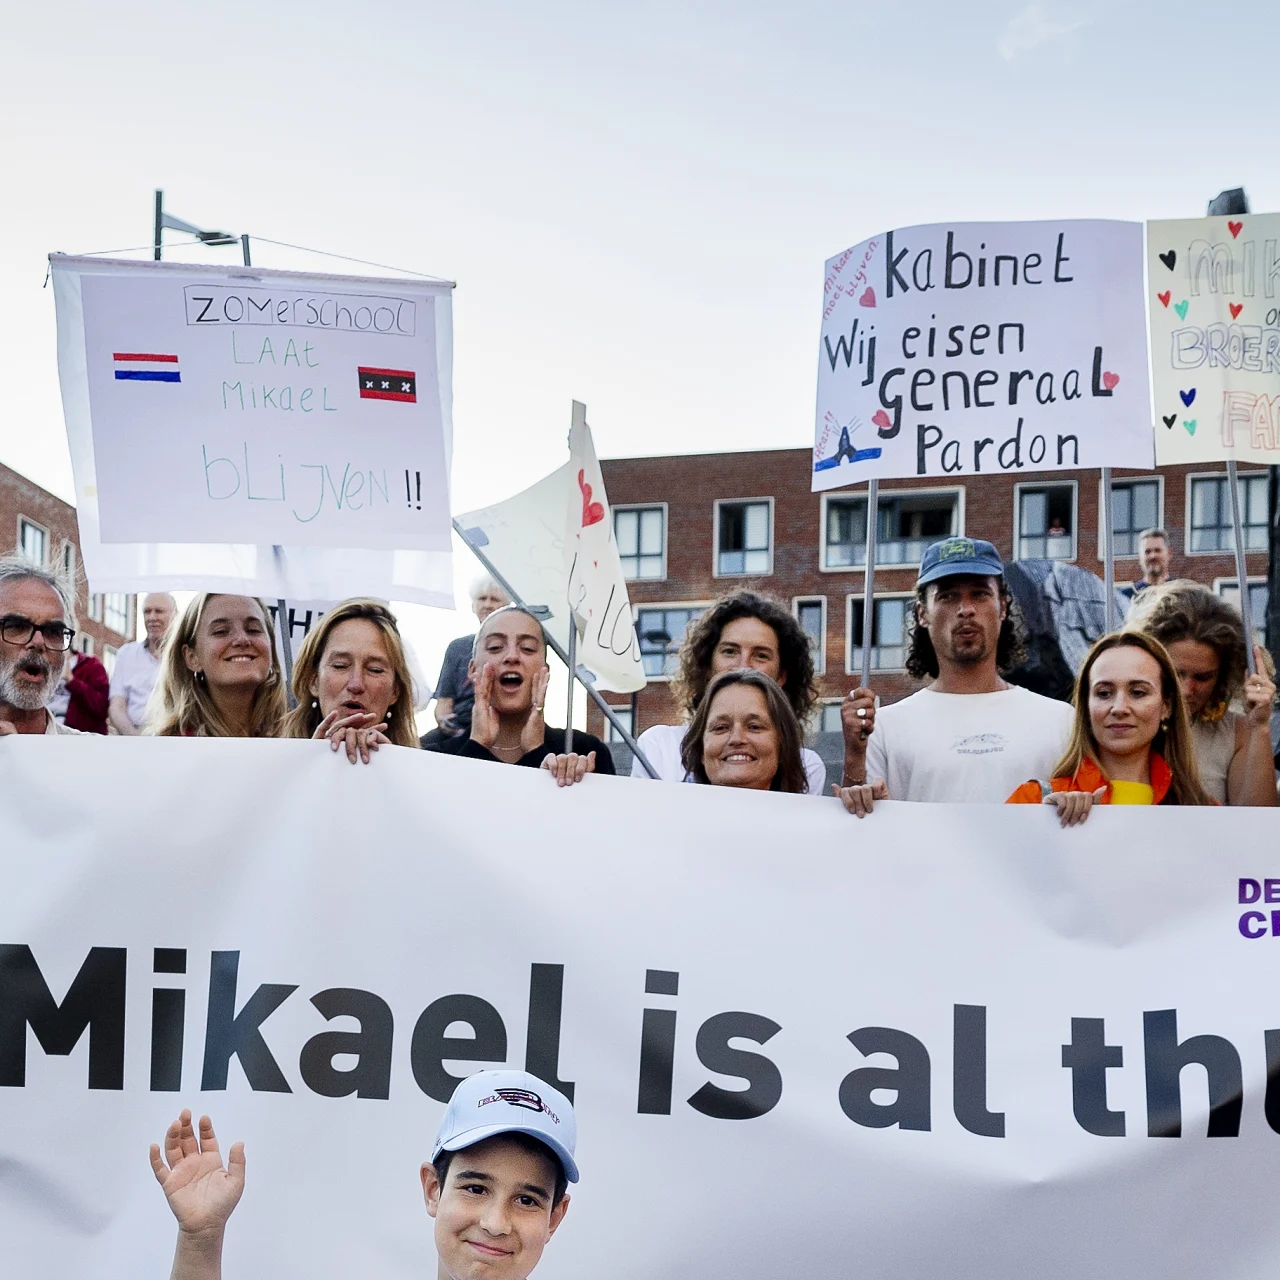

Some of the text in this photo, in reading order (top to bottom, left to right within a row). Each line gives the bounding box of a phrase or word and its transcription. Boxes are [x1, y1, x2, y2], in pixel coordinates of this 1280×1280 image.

[824, 313, 1025, 387] Wij eisen
[916, 417, 1080, 475] Pardon
[638, 969, 783, 1121] is
[839, 1004, 1005, 1137] al
